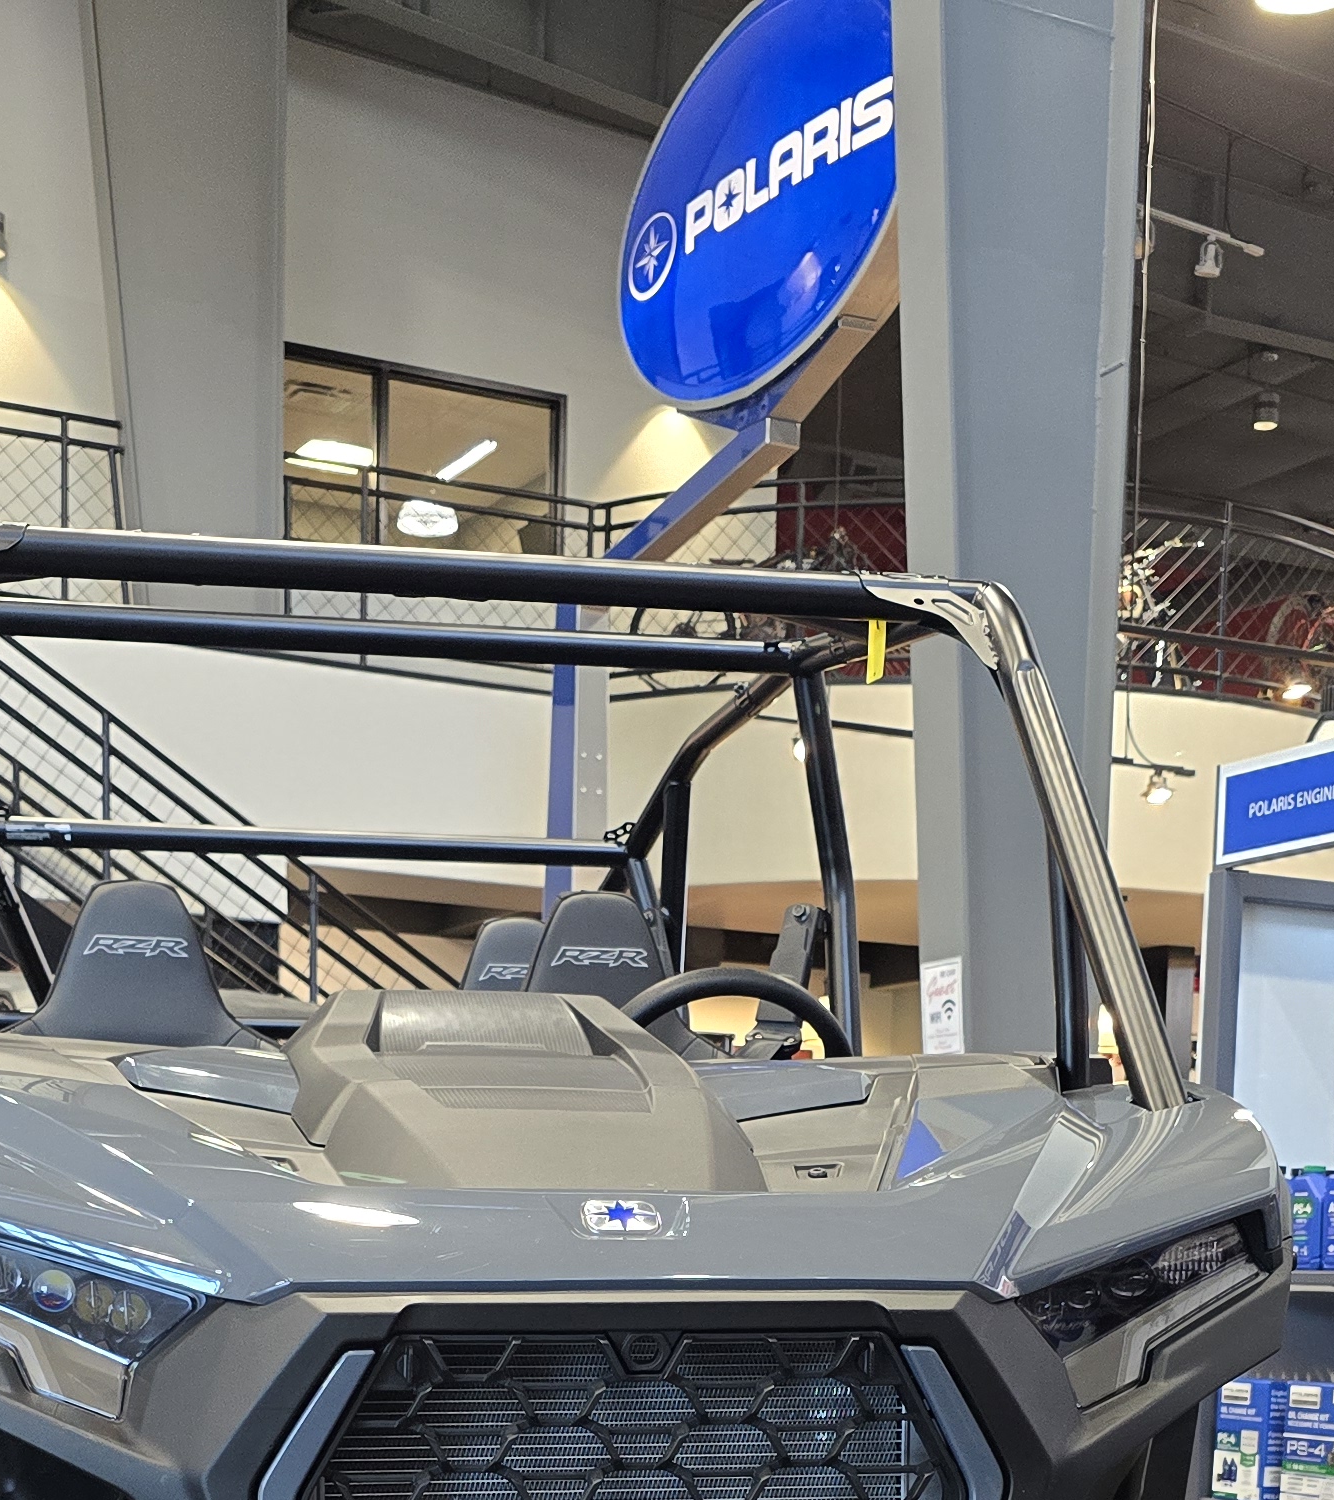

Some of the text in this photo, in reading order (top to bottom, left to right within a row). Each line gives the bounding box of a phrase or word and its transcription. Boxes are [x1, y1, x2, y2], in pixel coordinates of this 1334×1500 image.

[685, 76, 894, 255] POLARIS
[1248, 794, 1295, 818] POLARIS
[83, 933, 189, 958] RZR
[551, 946, 649, 968] RZR
[479, 963, 530, 981] RZ
[1286, 1440, 1326, 1458] PS-4
